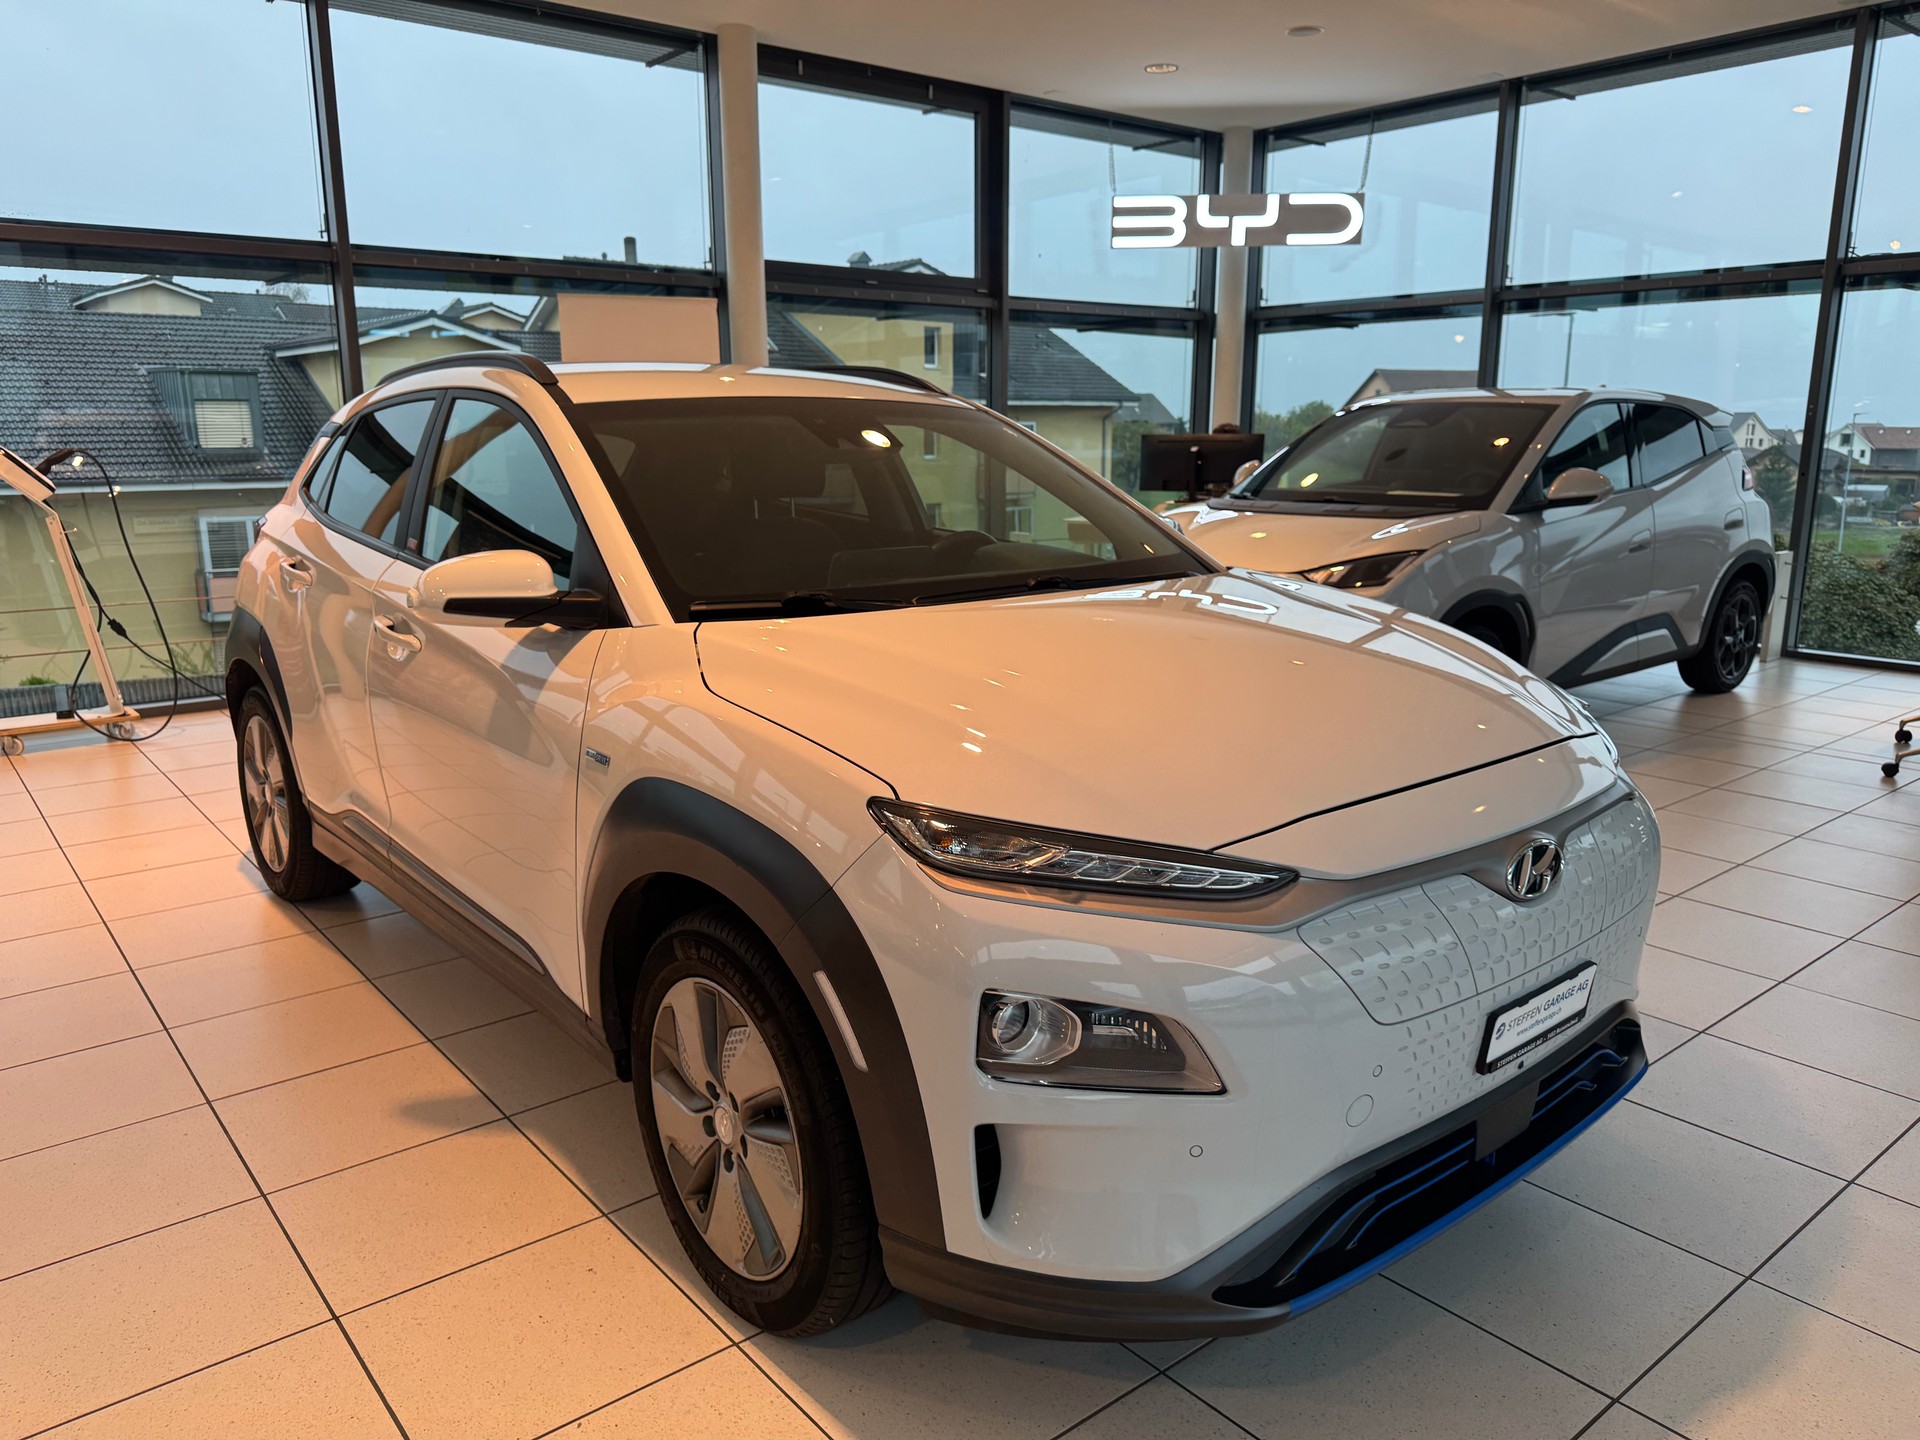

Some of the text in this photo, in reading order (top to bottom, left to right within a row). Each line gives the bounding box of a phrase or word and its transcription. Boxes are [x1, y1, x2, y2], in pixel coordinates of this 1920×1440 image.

[1112, 193, 1363, 248] BYD
[700, 945, 767, 1017] MICHELIN
[1507, 1004, 1543, 1032] STEFFEN
[1543, 986, 1575, 1011] GARAGE
[1576, 979, 1589, 993] AG
[1497, 1053, 1518, 1068] STEFFEN
[1518, 1041, 1537, 1056] GARAGE
